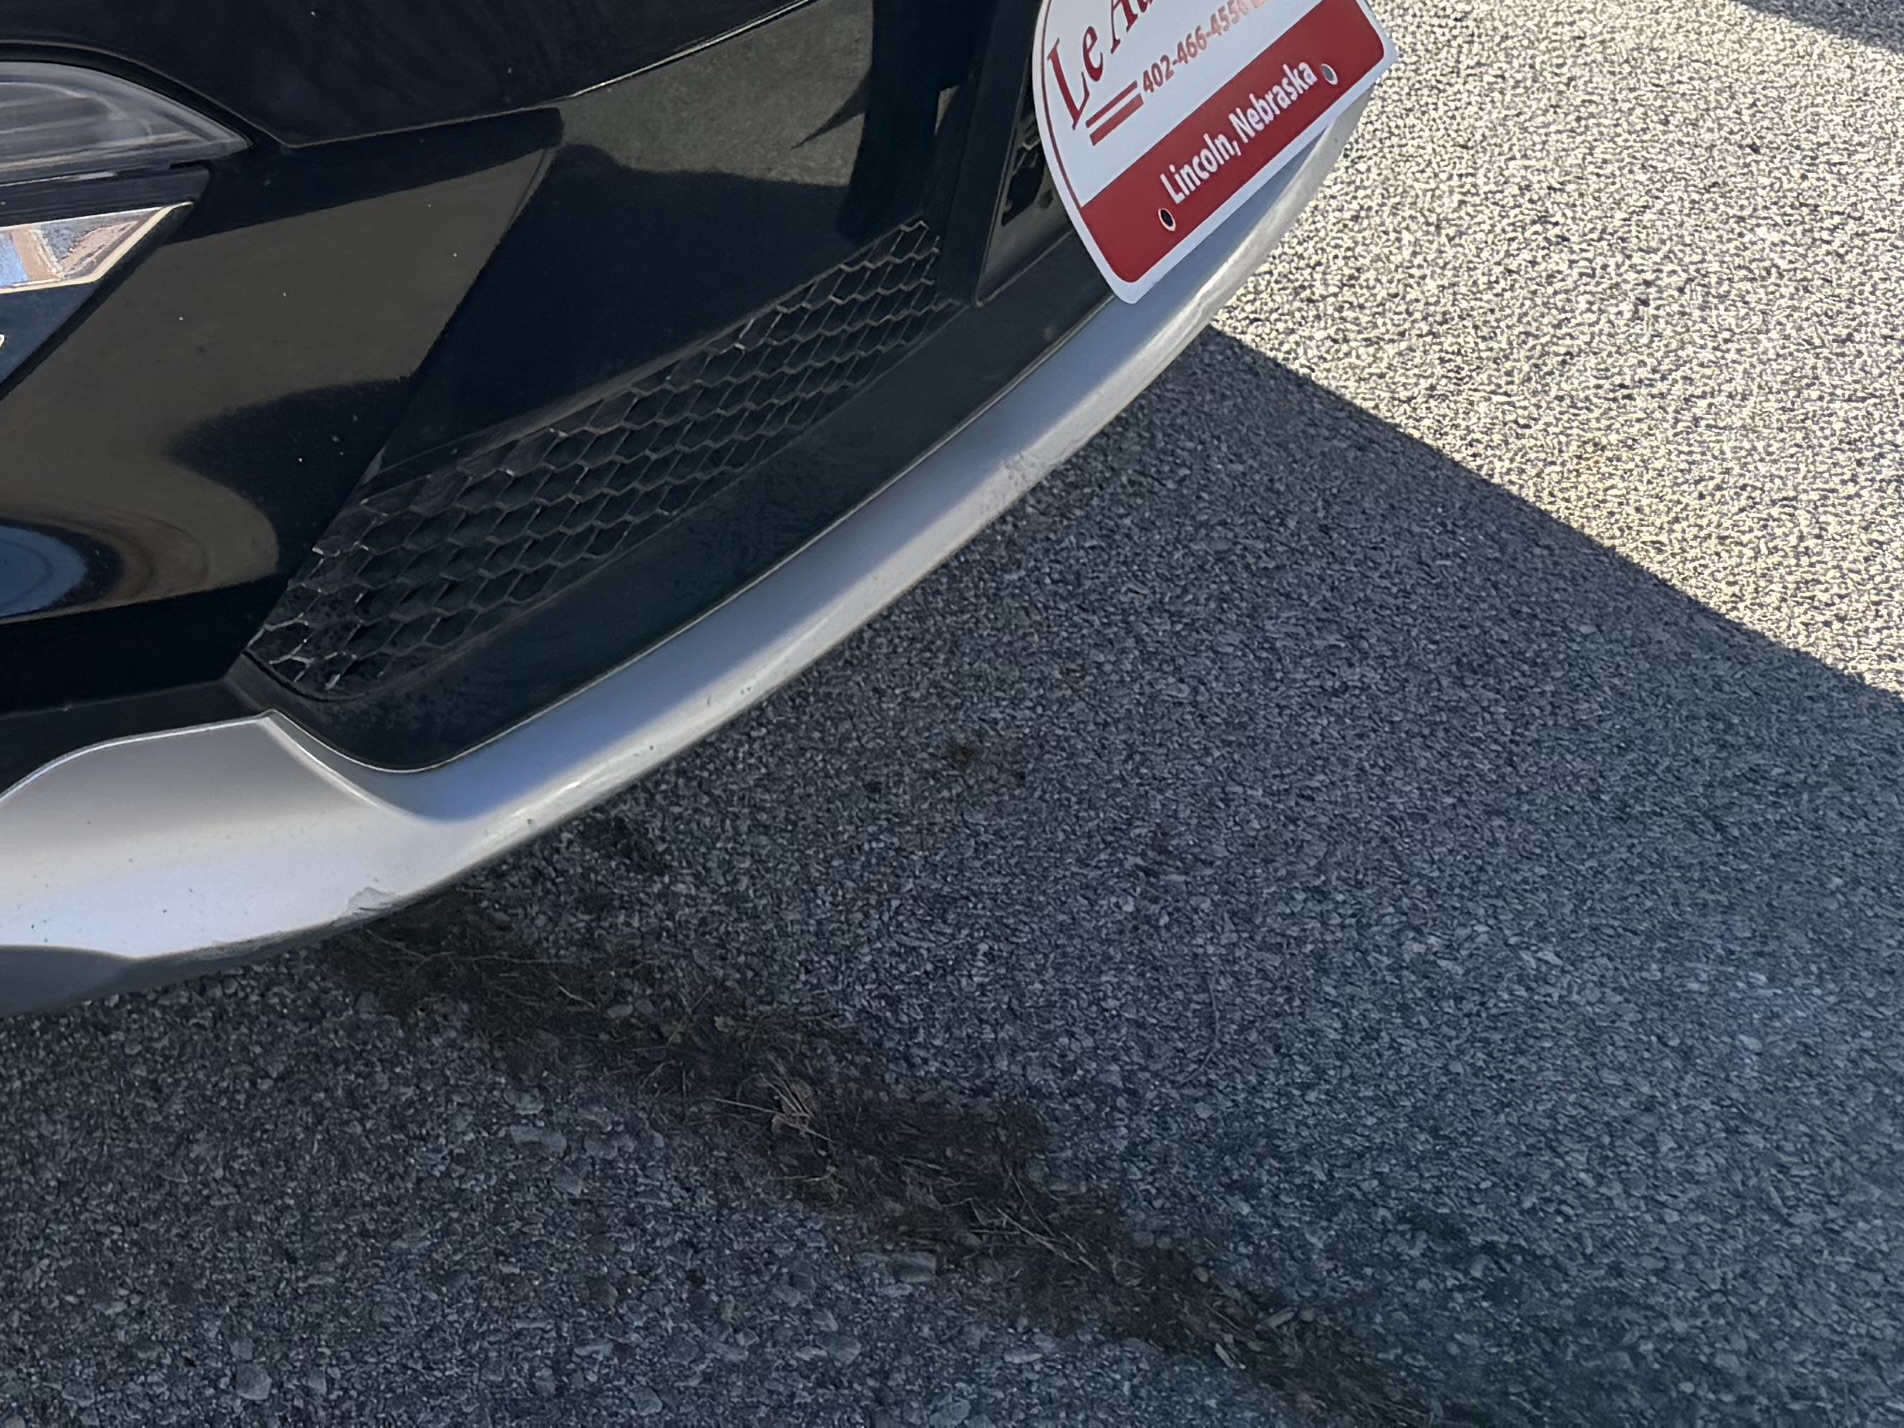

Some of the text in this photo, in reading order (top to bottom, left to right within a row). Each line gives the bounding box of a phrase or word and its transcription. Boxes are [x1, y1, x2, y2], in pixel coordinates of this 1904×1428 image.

[1047, 26, 1104, 131] Le
[1159, 60, 1318, 205] Lincoln, Nebraska
